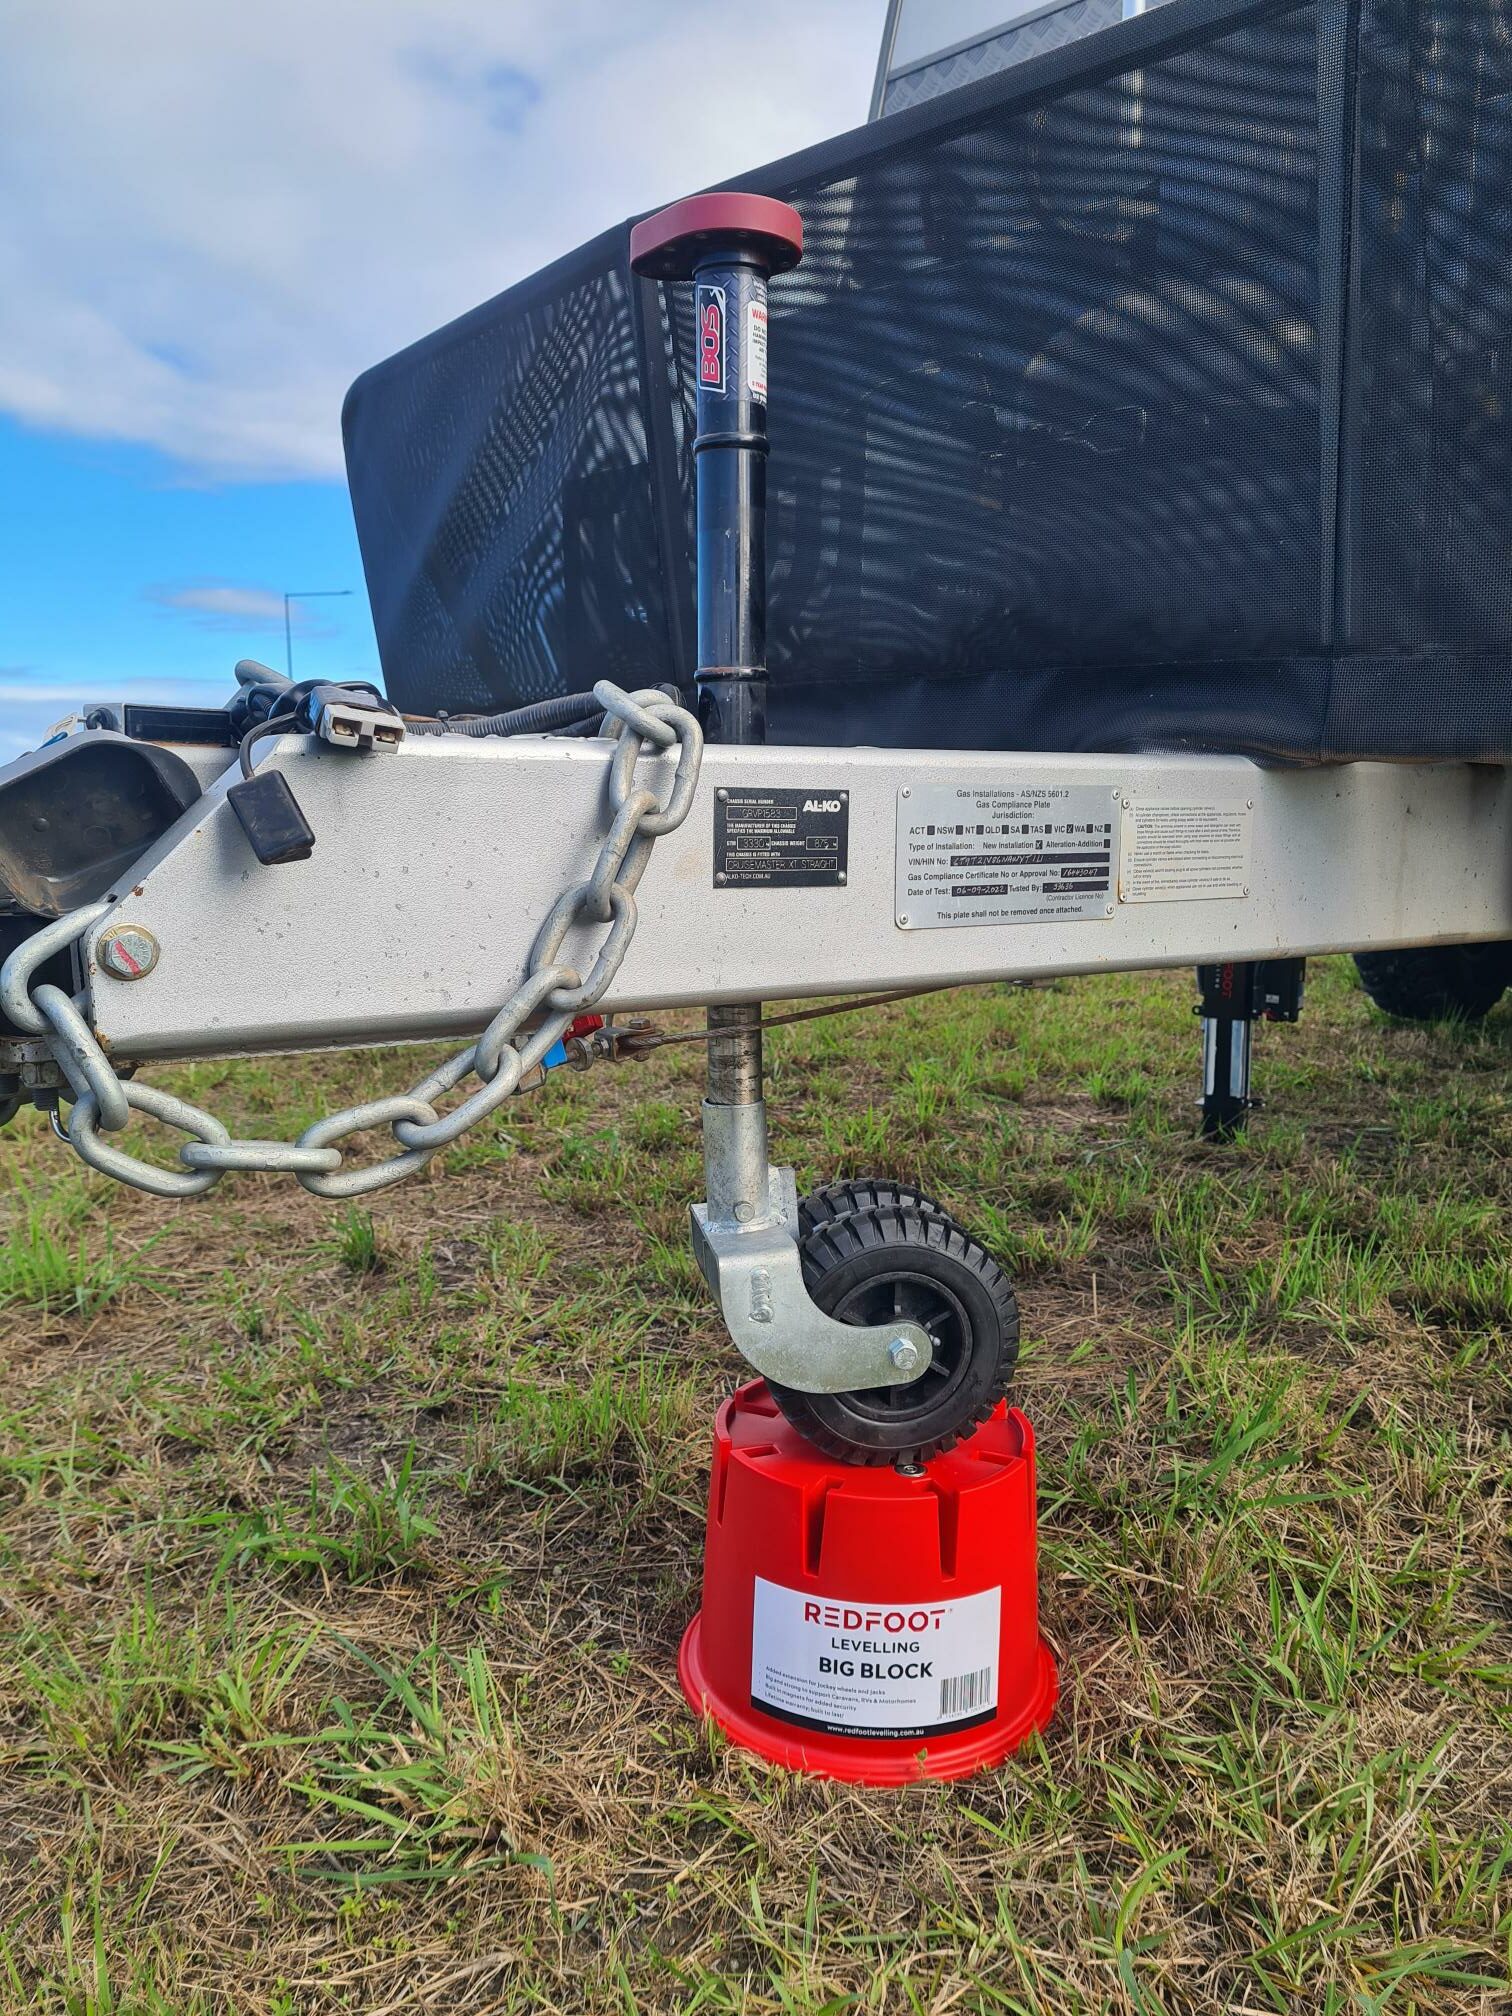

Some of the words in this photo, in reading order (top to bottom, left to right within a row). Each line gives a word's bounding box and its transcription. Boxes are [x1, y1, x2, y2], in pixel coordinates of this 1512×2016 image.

[701, 303, 720, 384] BOS
[957, 790, 971, 798] Gas
[973, 790, 1014, 798] Installations
[1021, 790, 1046, 798] AS/NZS
[1048, 790, 1069, 798] 5601.2
[803, 800, 841, 812] AL-KO
[992, 801, 1033, 810] Compliance
[1034, 801, 1050, 809] Plate
[910, 827, 925, 835] ACT
[965, 826, 976, 834] NT
[985, 826, 1000, 834] QLD
[1010, 826, 1020, 834] SA
[1054, 825, 1065, 833] VIC
[1075, 825, 1086, 833] WA
[1094, 825, 1103, 833] NZ
[909, 843, 924, 852] Type
[925, 843, 934, 851] of
[935, 842, 975, 851] Installation:
[983, 841, 997, 849] New
[999, 840, 1034, 849] Installation
[1046, 840, 1103, 848] Alteration-Addition
[728, 860, 786, 870] CRUISEMASTER
[802, 860, 835, 869] STRAIGHT
[908, 858, 935, 866] VIN/HIN
[937, 857, 949, 865] No:
[908, 873, 922, 881] Gas
[923, 871, 964, 881] Compliance
[966, 870, 999, 879] Certificate
[1001, 870, 1009, 878] No
[1019, 870, 1048, 879] Approval
[1049, 869, 1060, 877] No:
[908, 888, 923, 896] Date
[925, 887, 933, 895] of
[934, 887, 951, 895] Test:
[1009, 884, 1030, 892] Tested
[1031, 884, 1042, 892] By:
[938, 911, 951, 919] This
[953, 910, 969, 920] plate
[972, 909, 987, 919] shall
[989, 909, 999, 917] not
[1001, 908, 1009, 916] be
[1011, 907, 1038, 916] removed
[1040, 907, 1055, 915] once
[1055, 905, 1083, 914] attached.
[804, 1602, 946, 1633] REDFOOT
[831, 1638, 920, 1653] LEVELLING
[819, 1657, 855, 1677] BIG
[861, 1662, 933, 1679] BLOCK
[766, 1666, 782, 1676] Added
[783, 1673, 807, 1684] extension
[784, 1682, 801, 1692] strong
[809, 1690, 831, 1698] support
[765, 1692, 784, 1703] Lifetime
[782, 1691, 805, 1701] magnets
[834, 1703, 856, 1711] security
[827, 1724, 925, 1738] www.redfootlevelling.com.au
